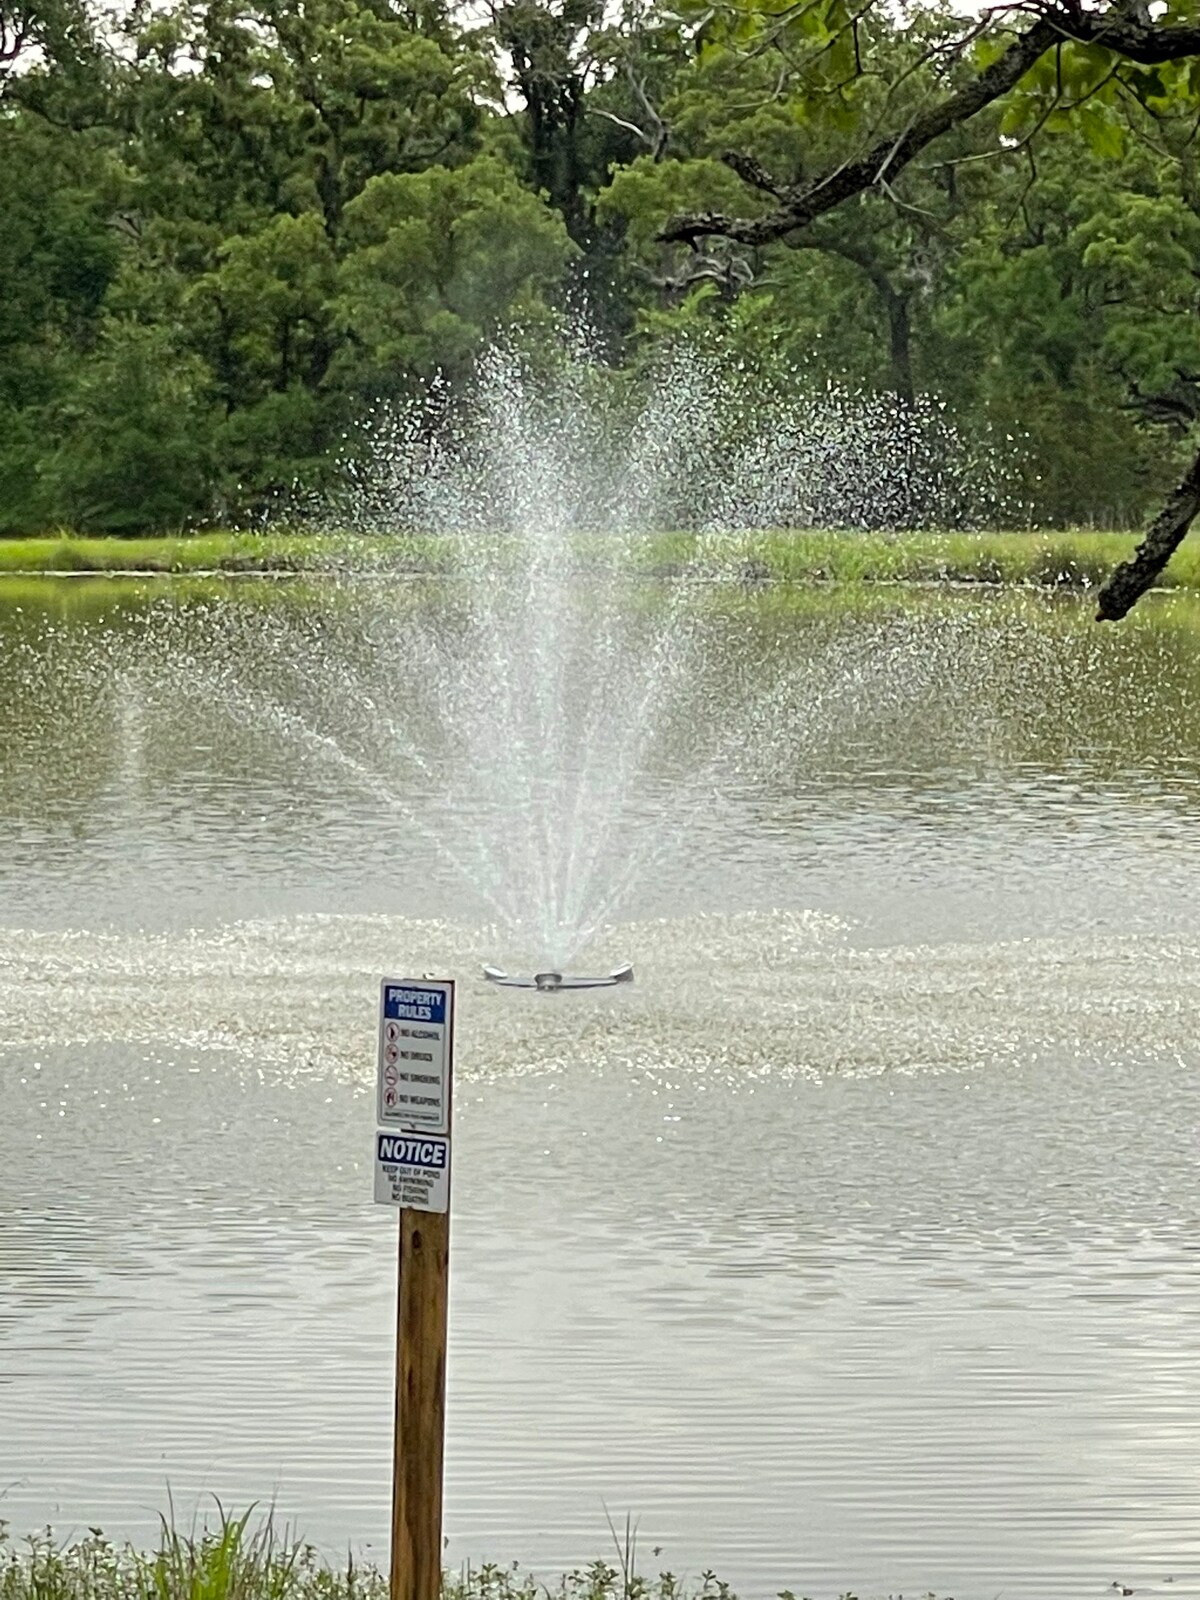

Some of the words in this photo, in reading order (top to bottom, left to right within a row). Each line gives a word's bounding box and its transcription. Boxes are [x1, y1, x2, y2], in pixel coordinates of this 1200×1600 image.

[389, 988, 442, 1006] PROPERTY
[398, 1003, 431, 1020] RULES
[401, 1029, 410, 1037] NO
[401, 1051, 409, 1060] NO
[400, 1073, 409, 1081] NO
[400, 1094, 408, 1103] NO
[380, 1138, 445, 1164] NOTICE
